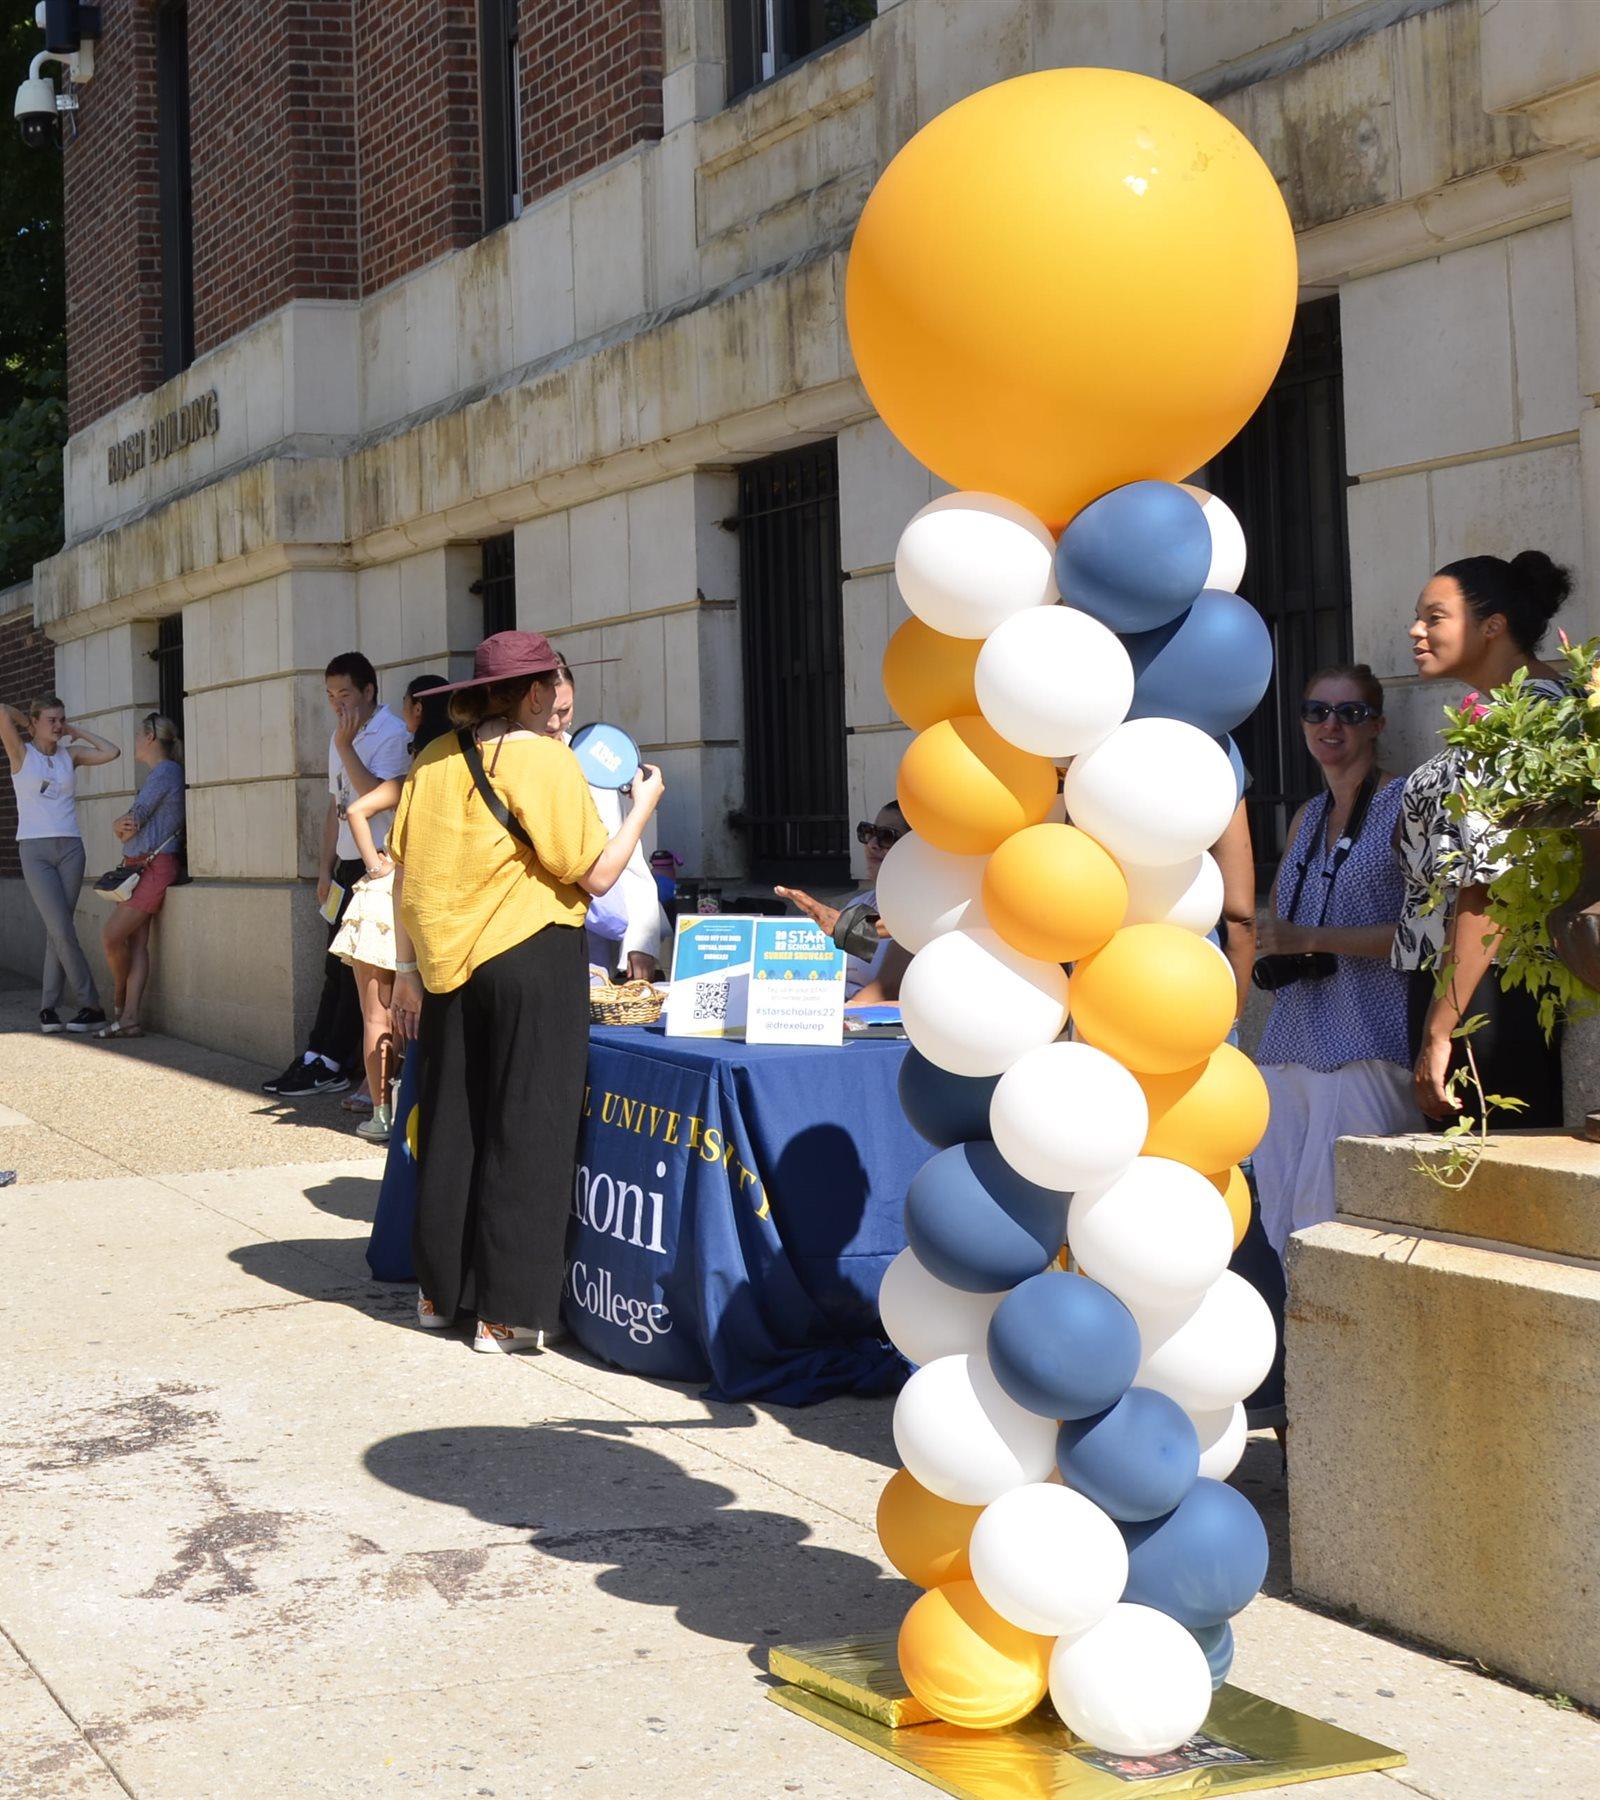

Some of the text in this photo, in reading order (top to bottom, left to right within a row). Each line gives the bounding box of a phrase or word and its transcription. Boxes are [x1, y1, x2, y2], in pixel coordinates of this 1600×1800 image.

[108, 388, 220, 486] RUSH BUILDING
[788, 930, 826, 944] STAR
[756, 1007, 836, 1017] #starscholars22
[572, 1260, 673, 1344] College
